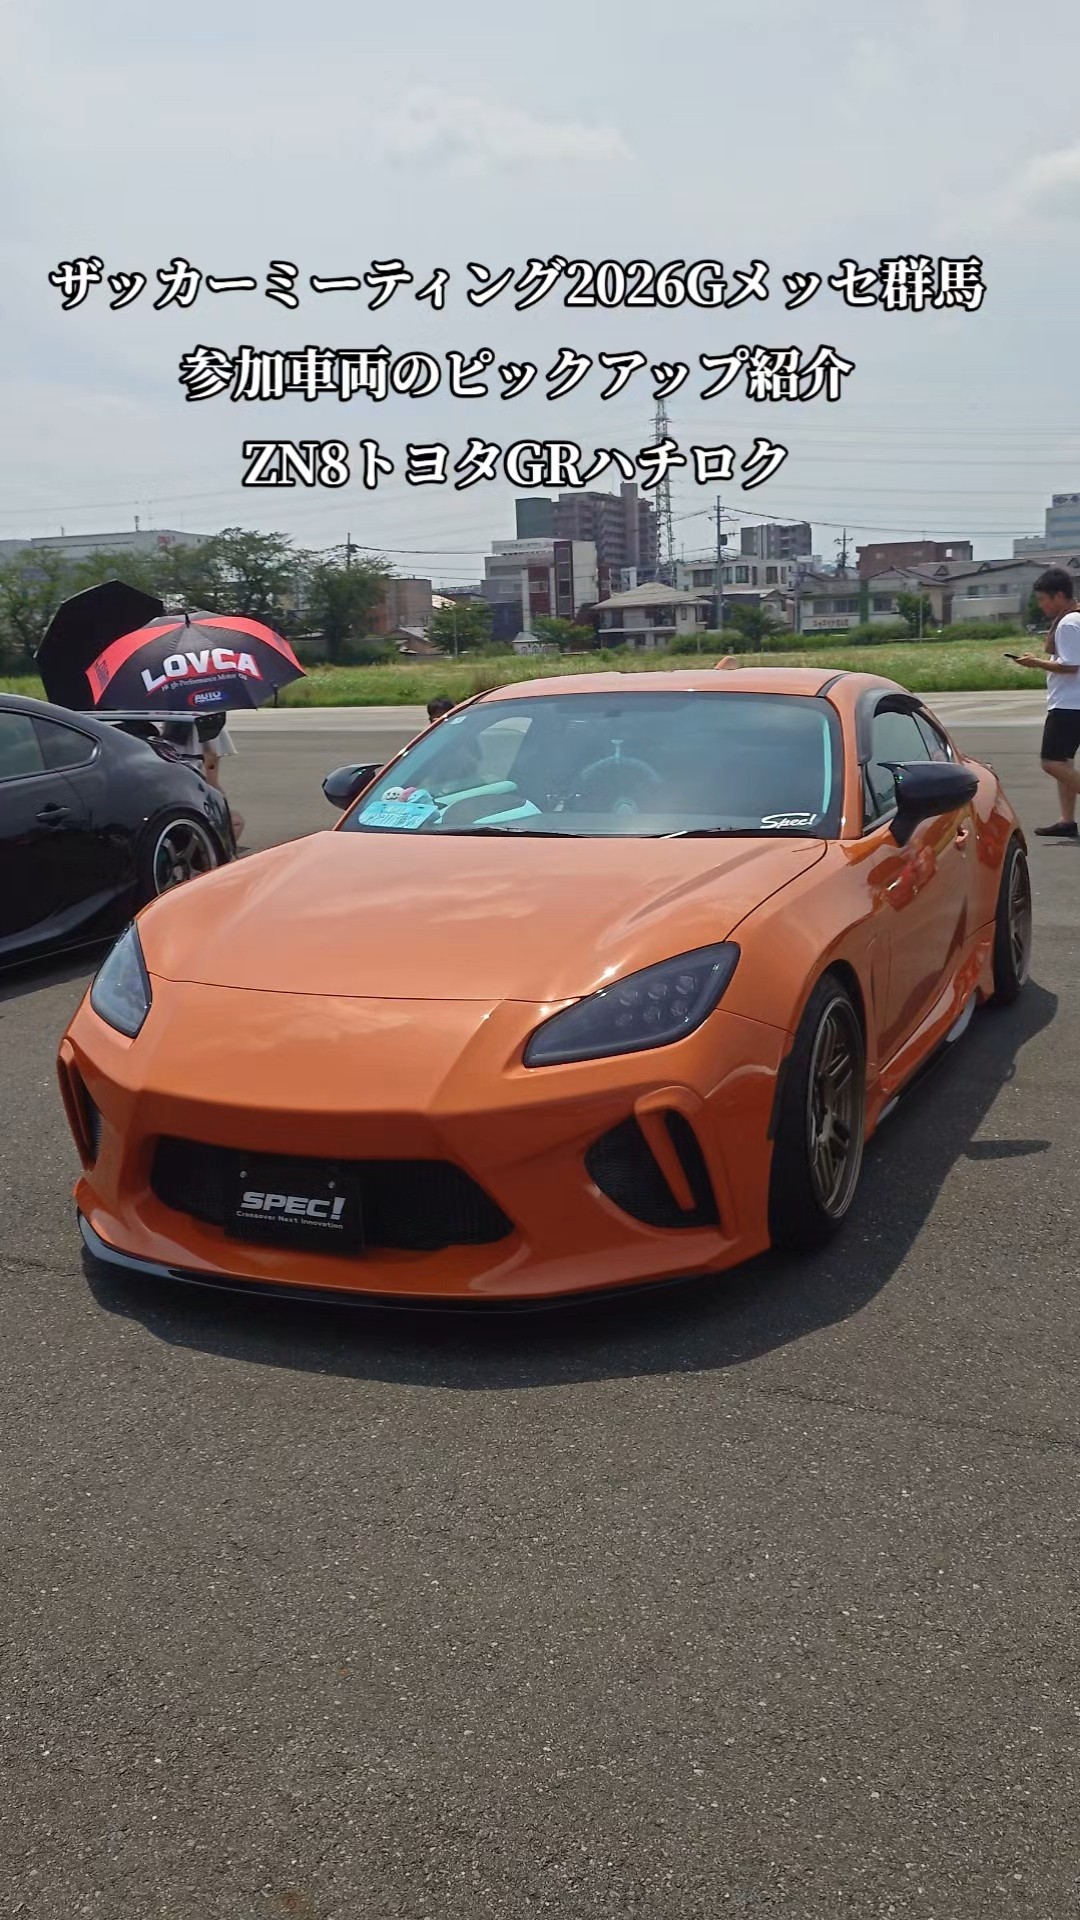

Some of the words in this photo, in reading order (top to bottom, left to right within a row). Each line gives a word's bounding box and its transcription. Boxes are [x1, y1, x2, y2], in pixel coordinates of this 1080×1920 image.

[141, 648, 260, 692] LOVCA
[180, 676, 217, 687] Performance
[217, 673, 237, 681] Motor
[194, 691, 221, 700] AUTO
[240, 1191, 346, 1221] SPEC!
[236, 1210, 276, 1221] Crossover
[278, 1215, 298, 1224] Next
[300, 1218, 344, 1230] Innovation
